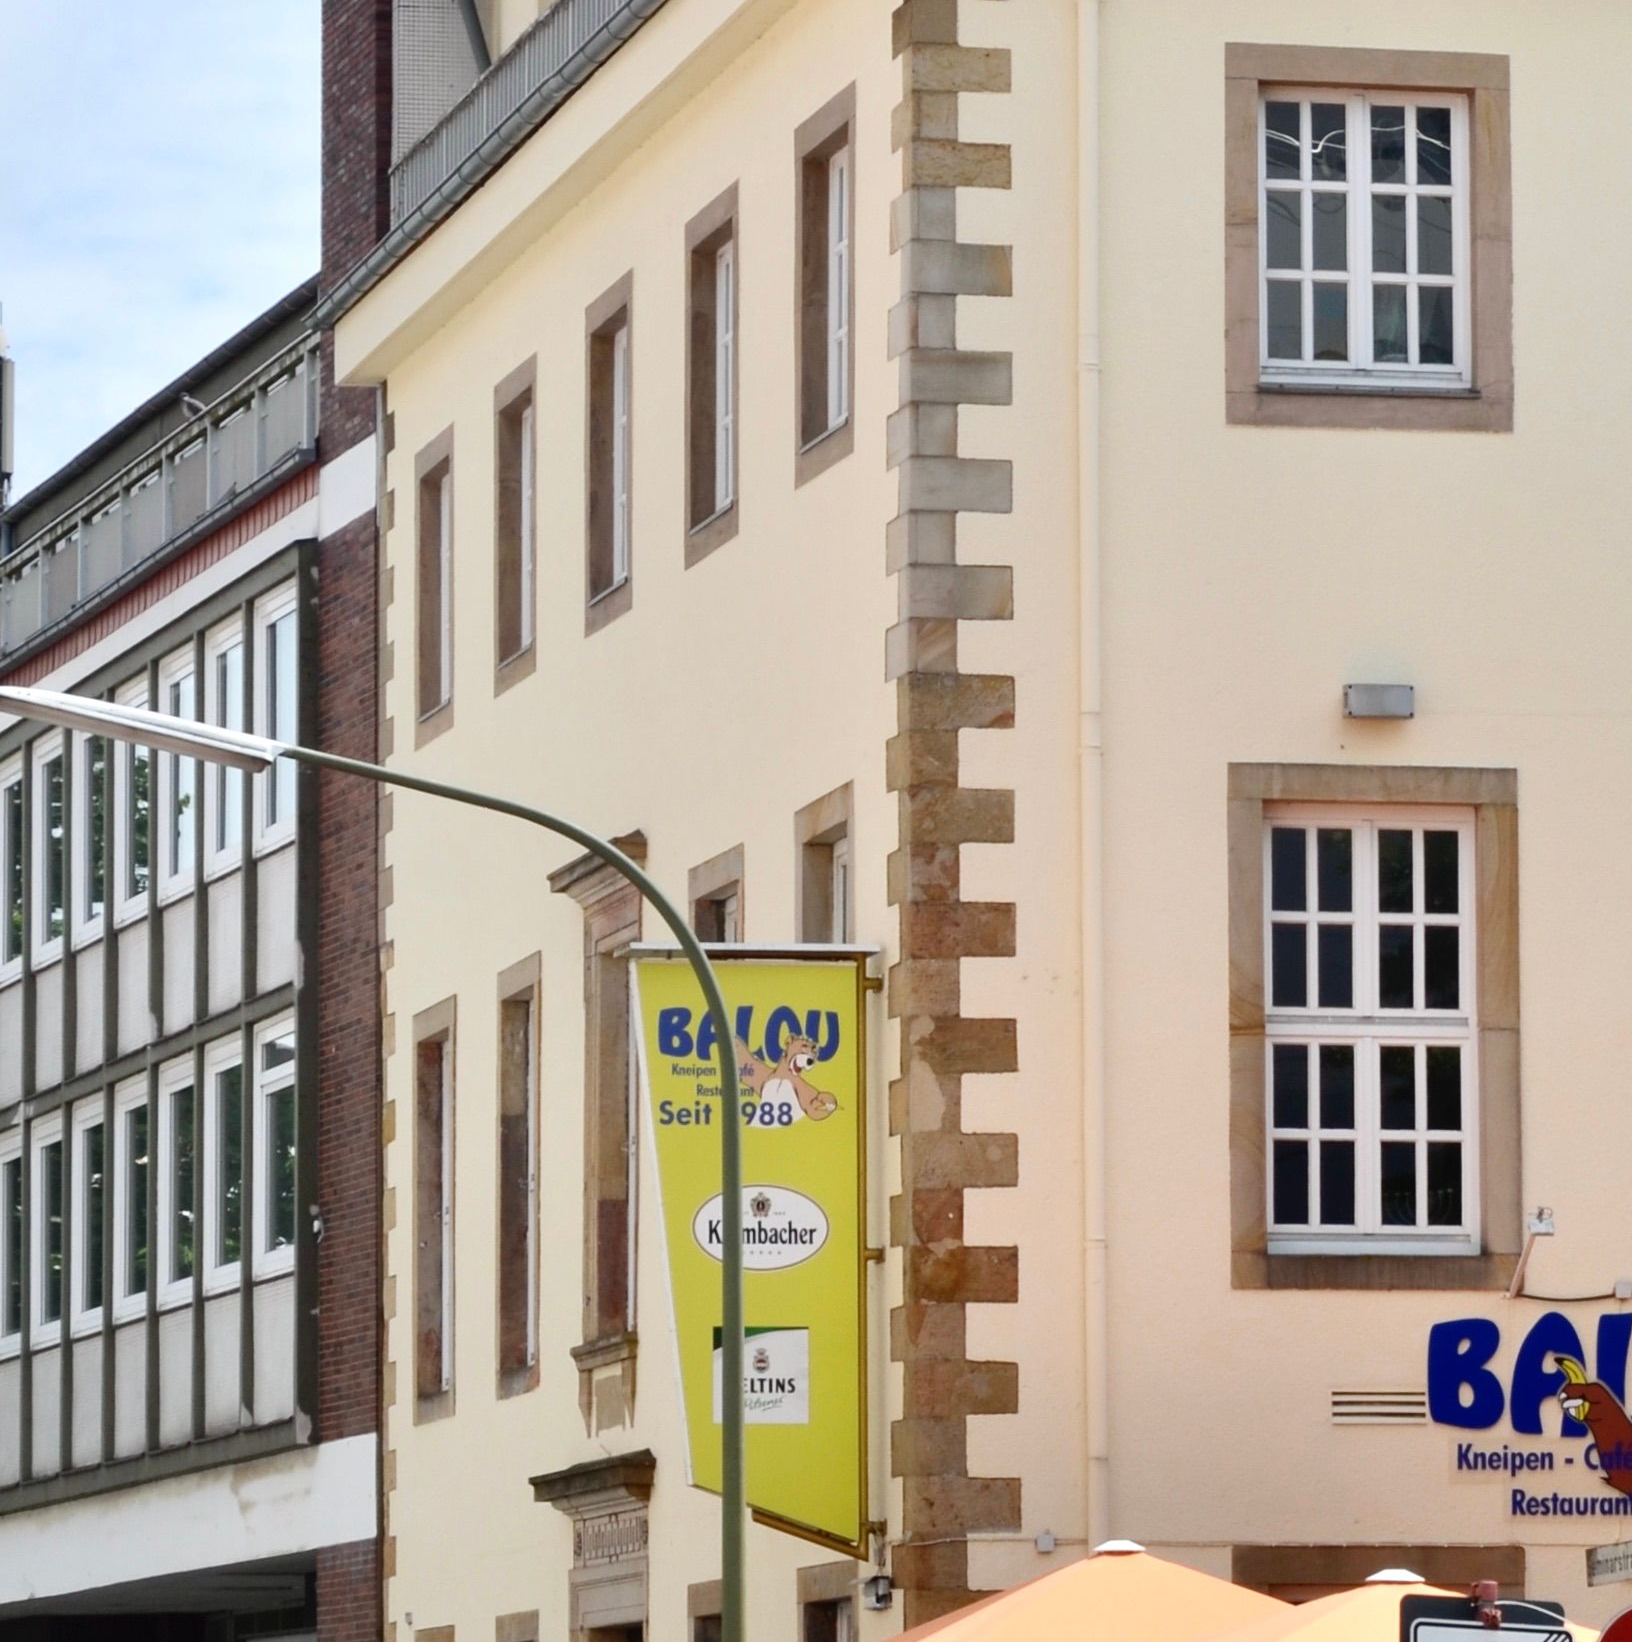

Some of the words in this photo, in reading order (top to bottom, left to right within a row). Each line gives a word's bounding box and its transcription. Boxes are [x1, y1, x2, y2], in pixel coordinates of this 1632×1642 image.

[659, 1100, 712, 1126] Seit
[741, 1101, 793, 1126] 988
[1457, 1442, 1555, 1478] Kneipen
